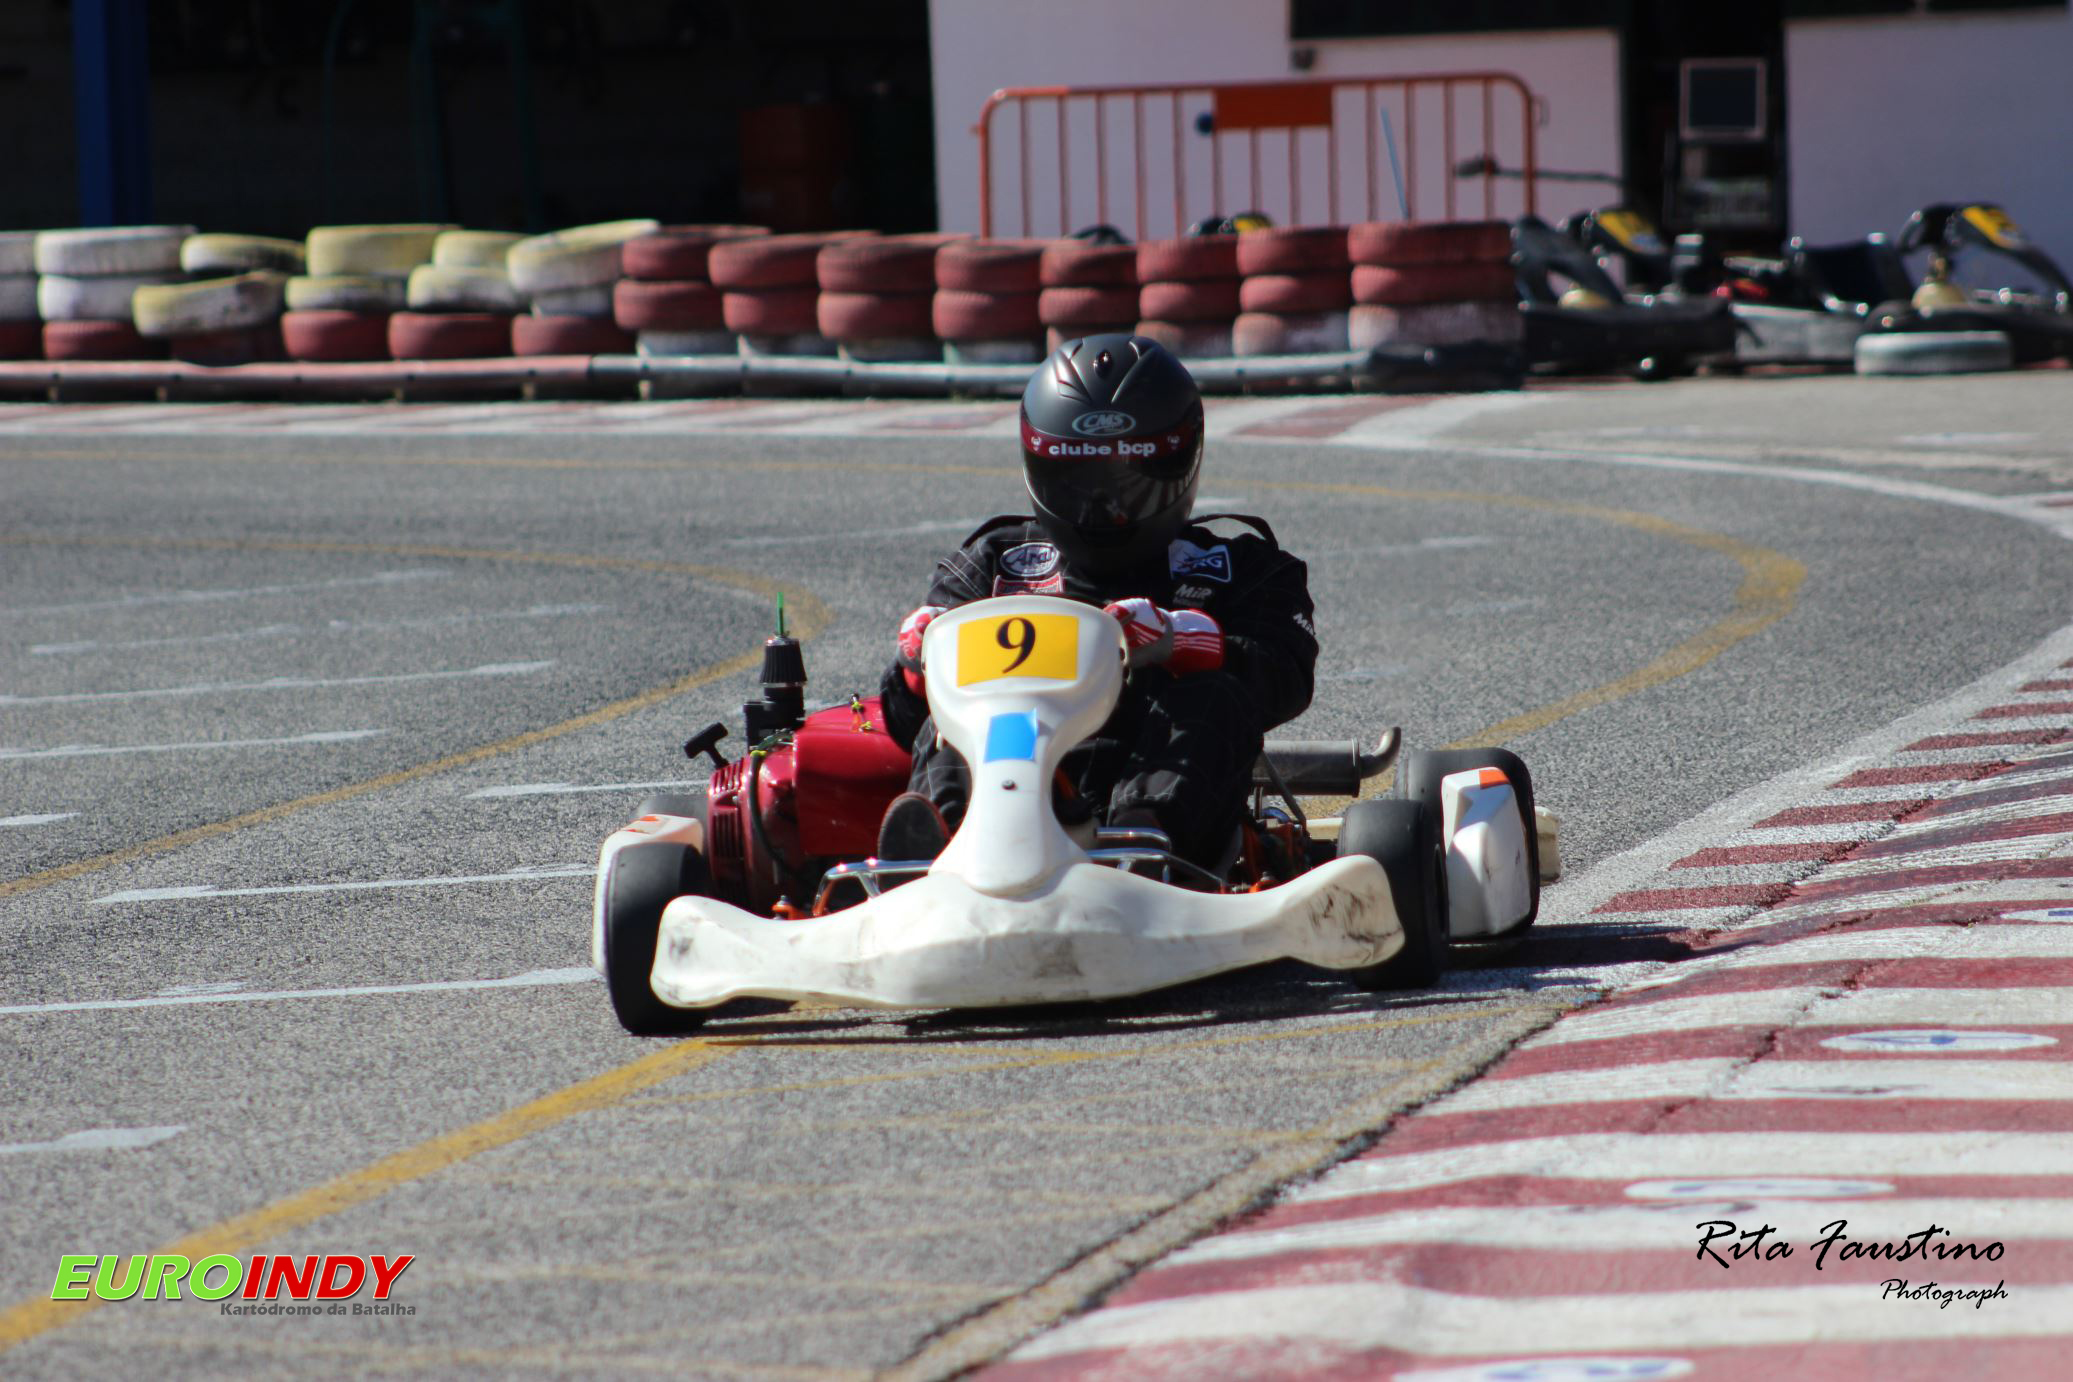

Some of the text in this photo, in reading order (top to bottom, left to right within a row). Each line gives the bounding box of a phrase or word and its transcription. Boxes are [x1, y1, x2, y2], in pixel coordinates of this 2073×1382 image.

[1048, 440, 1156, 457] clube bcp
[997, 617, 1036, 673] 9
